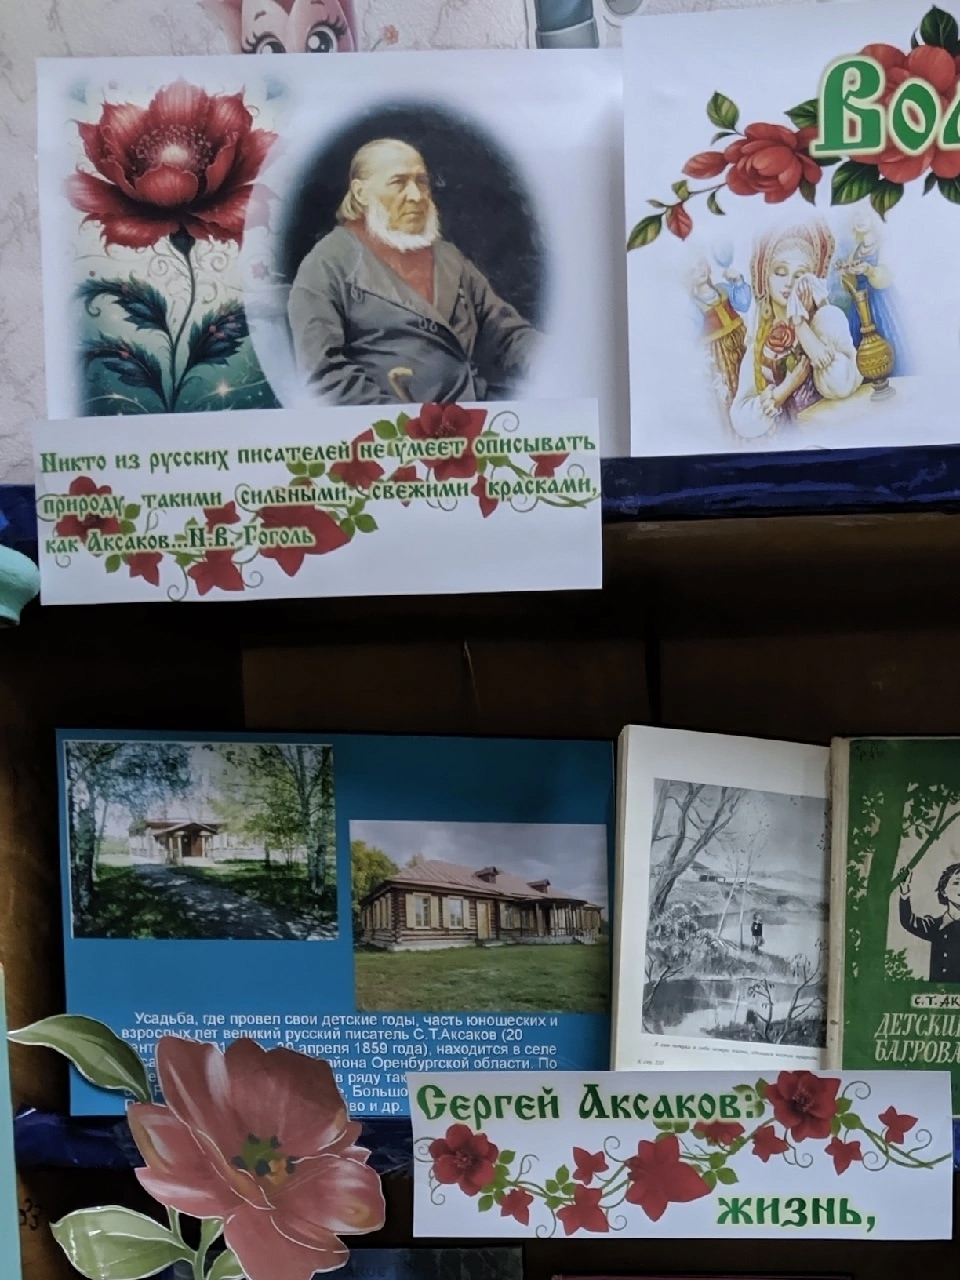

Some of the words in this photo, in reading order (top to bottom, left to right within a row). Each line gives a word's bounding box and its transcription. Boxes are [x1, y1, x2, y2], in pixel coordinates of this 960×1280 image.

[115, 452, 141, 471] из
[150, 447, 230, 474] русских
[237, 438, 351, 466] писателей
[359, 442, 389, 461] не
[394, 437, 466, 463] умеет
[474, 433, 597, 459] описывать
[42, 494, 126, 518] природу
[141, 489, 222, 509] такими
[241, 482, 354, 506] сильными,
[372, 478, 470, 501] свежими
[487, 475, 598, 501] красками,
[45, 536, 80, 554] как
[243, 525, 315, 550] Гоголь
[135, 1012, 199, 1026] Усадьба,
[202, 1016, 225, 1027] где
[230, 1015, 281, 1027] провел
[284, 1016, 317, 1025] свои
[322, 1015, 377, 1027] детские
[382, 1016, 419, 1028] годы,
[423, 1016, 463, 1026] часть
[466, 1016, 546, 1027] юношеских
[551, 1017, 558, 1027] и
[195, 1029, 219, 1040] лет
[224, 1027, 281, 1039] великий
[286, 1028, 341, 1041] русский
[345, 1028, 409, 1040] писатель
[501, 1028, 523, 1042] (20
[299, 1043, 349, 1055] апреля
[355, 1043, 388, 1054] 1859
[393, 1043, 432, 1056] года),
[437, 1044, 508, 1055] находится
[525, 1045, 557, 1055] селе
[327, 1057, 367, 1069] айона
[372, 1057, 469, 1071] Оренбургской
[474, 1057, 534, 1069] области.
[539, 1058, 558, 1069] По
[348, 1073, 381, 1086] ряду
[381, 1102, 404, 1115] др.
[416, 1083, 561, 1129] Сергей
[578, 1083, 756, 1120] Аксаков:
[716, 1195, 877, 1232] жизнь,
